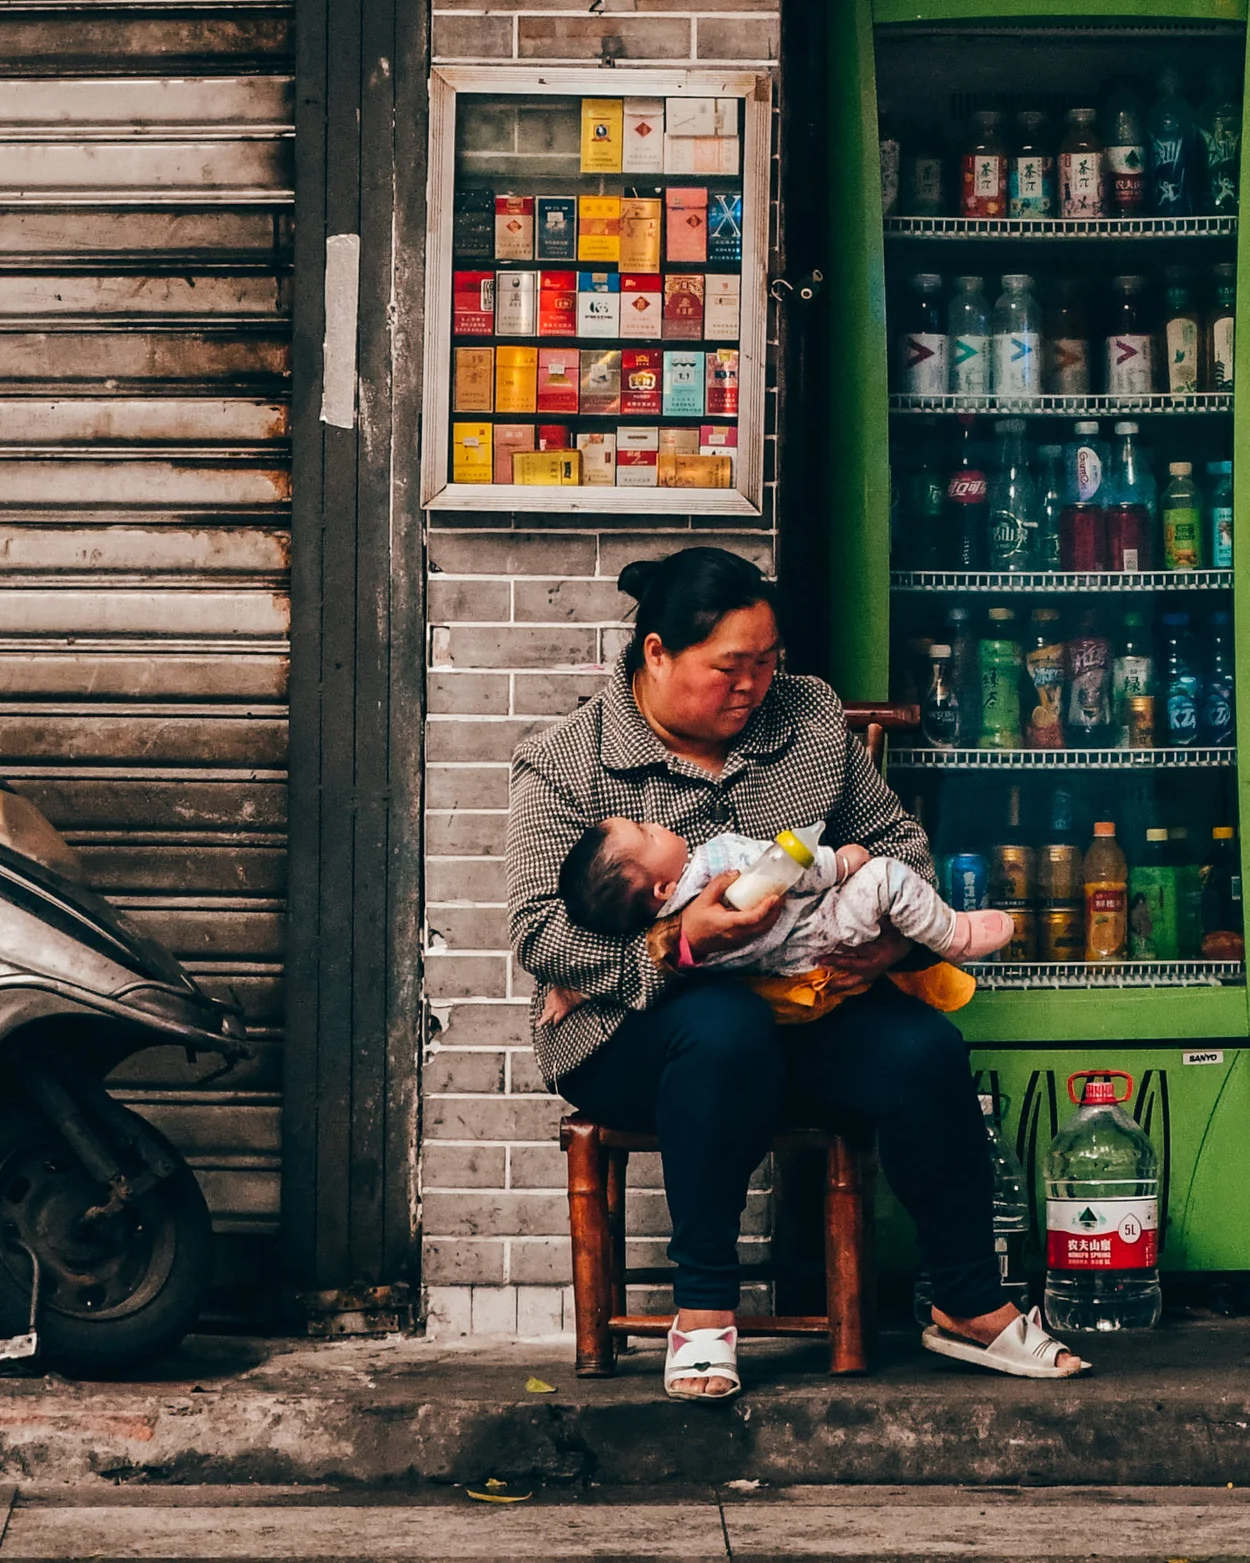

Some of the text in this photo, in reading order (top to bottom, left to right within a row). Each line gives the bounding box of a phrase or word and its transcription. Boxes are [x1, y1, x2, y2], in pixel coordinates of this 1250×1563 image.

[1189, 1053, 1218, 1062] SANYO
[1124, 1223, 1137, 1236] 5L
[1067, 1239, 1111, 1251] 农夫山泉
